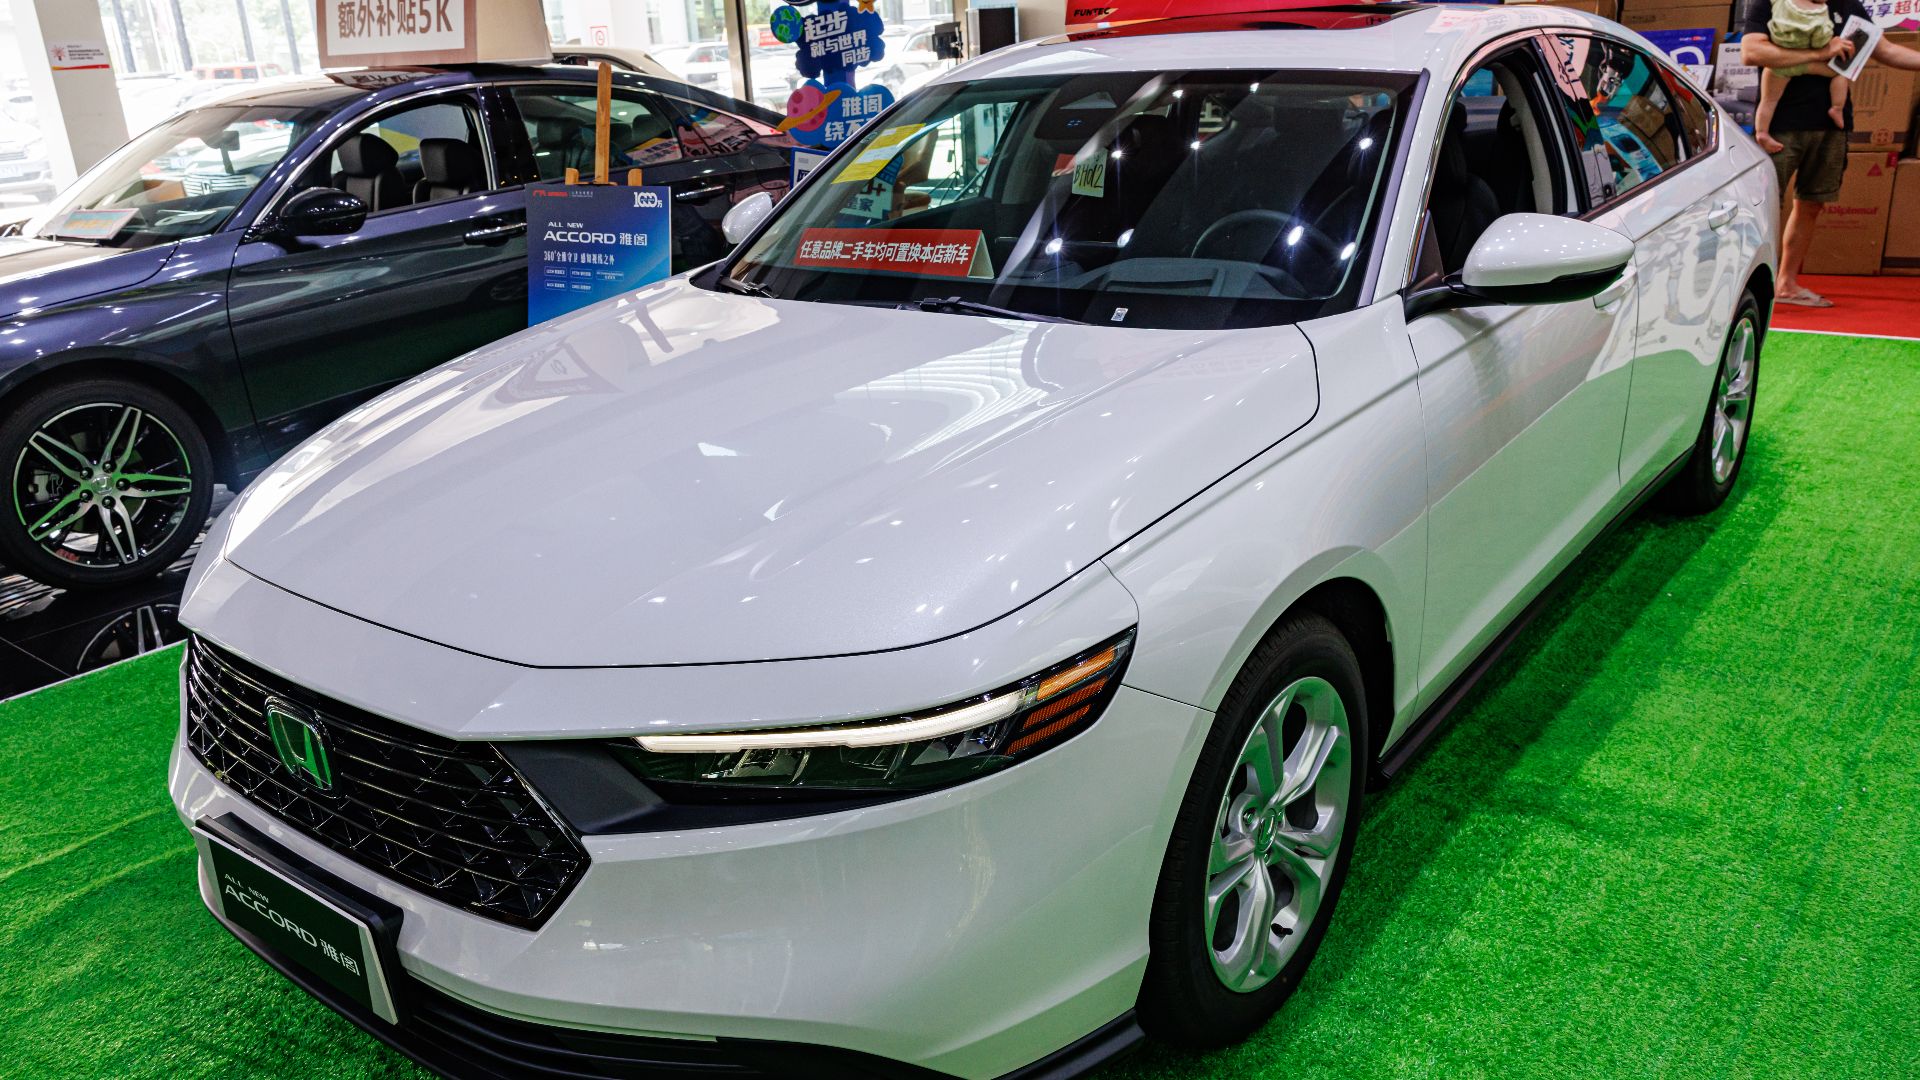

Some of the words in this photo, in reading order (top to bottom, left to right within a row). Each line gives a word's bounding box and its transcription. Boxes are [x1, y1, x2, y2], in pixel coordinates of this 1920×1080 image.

[338, 0, 453, 38] 额外补贴5K
[1074, 7, 1111, 17] FUNTEC
[804, 10, 848, 42] 起步
[810, 29, 867, 58] 就与世界
[841, 46, 871, 67] 同步
[842, 93, 882, 117] 雅阁
[824, 119, 877, 141] 绕不
[543, 230, 616, 245] ACCORD
[619, 232, 648, 246] 雅阁
[799, 239, 972, 265] 任意品牌二手车均可置换本店新车
[224, 873, 244, 889] ALL
[248, 886, 269, 904] NEW
[225, 884, 318, 948] ACCORD
[319, 938, 361, 977] 雅阁
